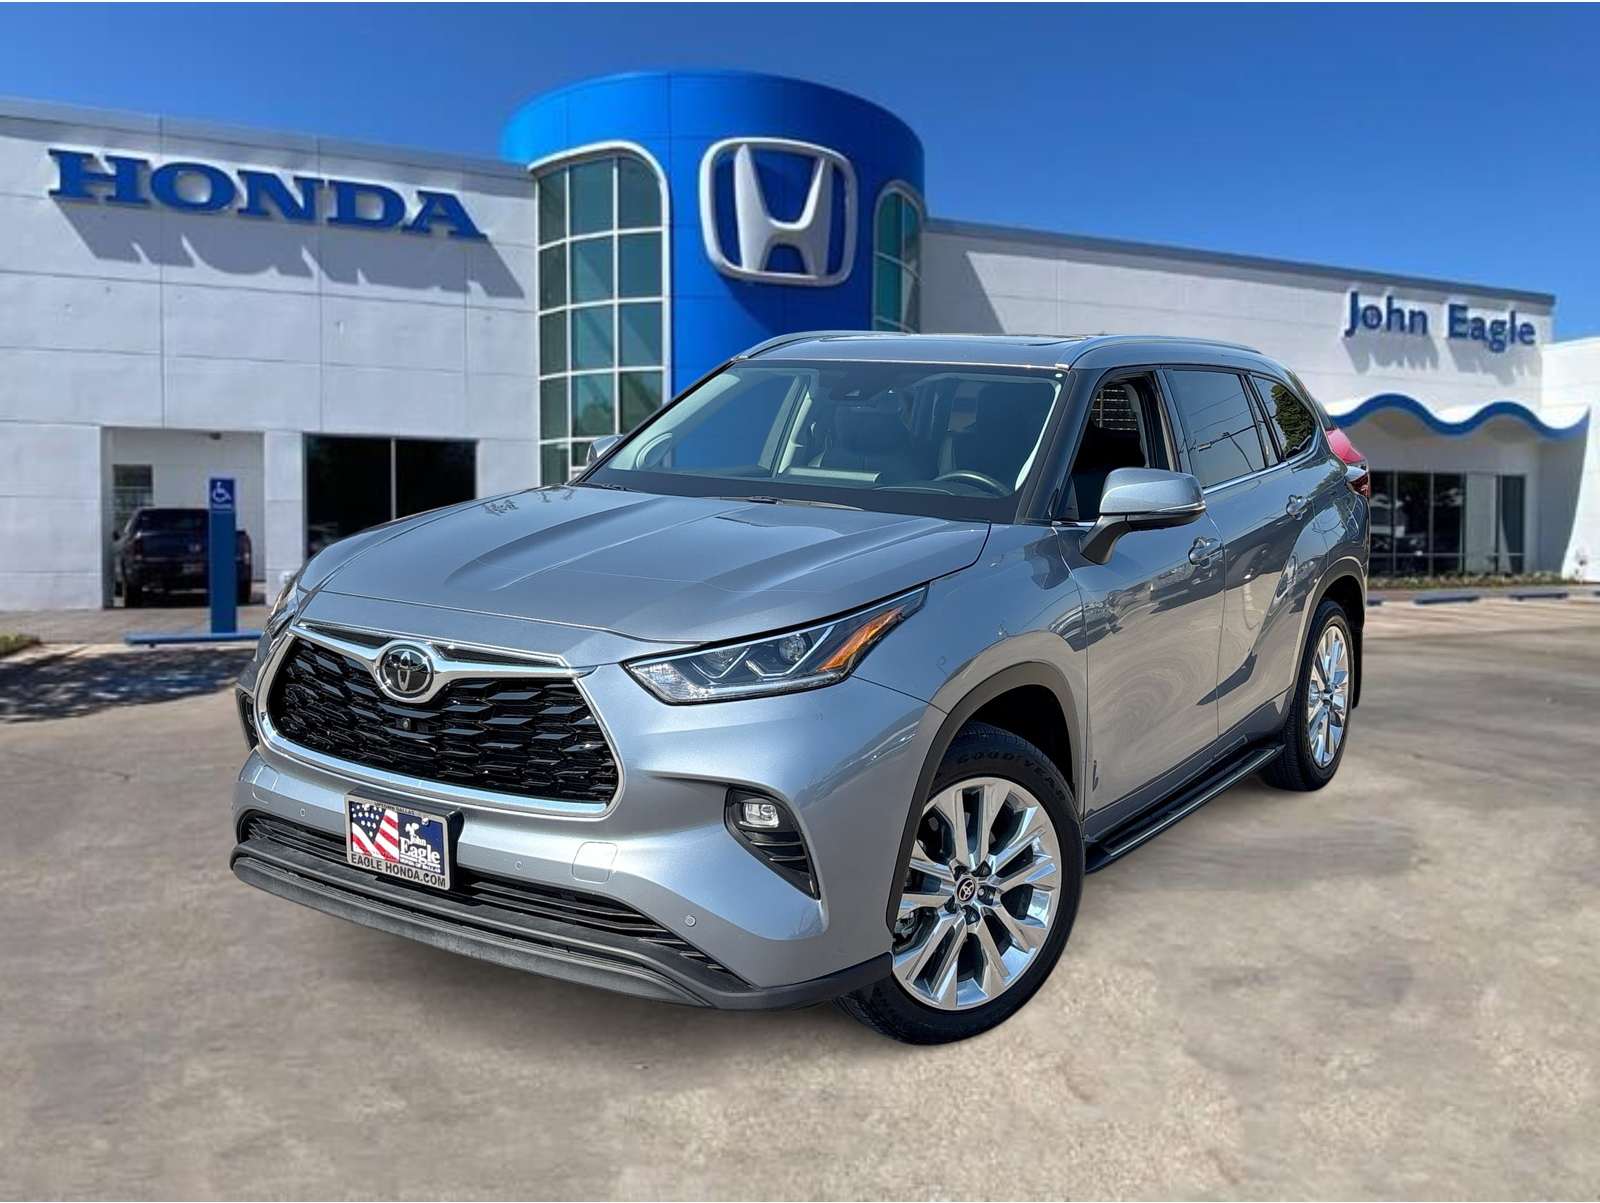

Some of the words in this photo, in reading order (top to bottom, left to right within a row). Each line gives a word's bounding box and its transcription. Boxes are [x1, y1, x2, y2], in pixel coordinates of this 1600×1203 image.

[48, 148, 488, 241] HONDA
[1344, 290, 1429, 338] John
[1448, 303, 1536, 354] Eagle
[400, 837, 440, 865] Eagle
[410, 834, 427, 847] John
[351, 854, 383, 871] EAGLE
[385, 861, 446, 888] HONDA.COM
